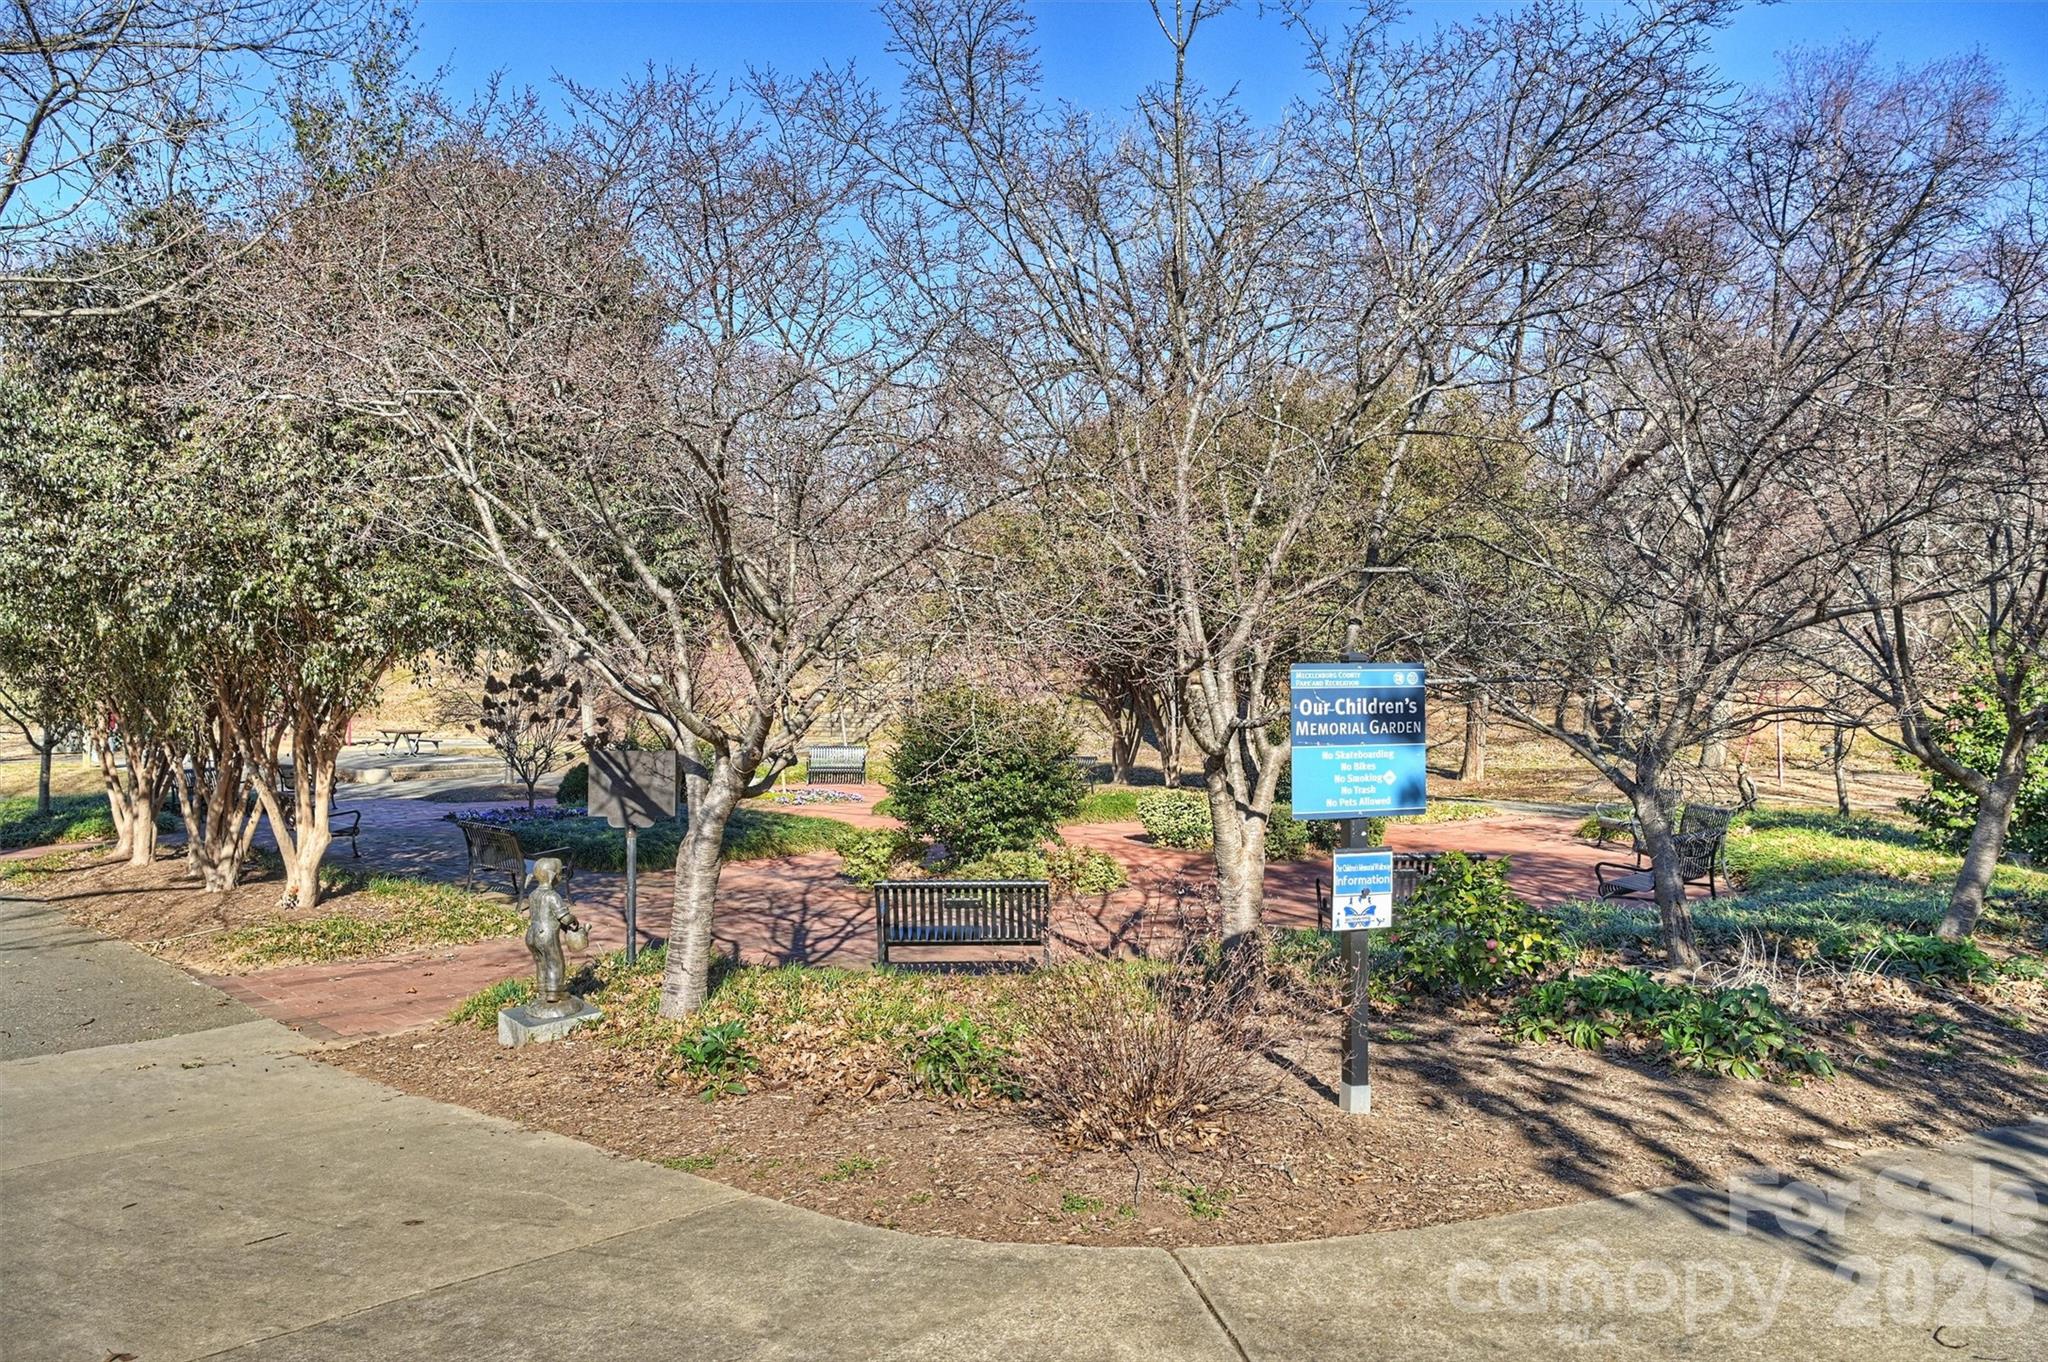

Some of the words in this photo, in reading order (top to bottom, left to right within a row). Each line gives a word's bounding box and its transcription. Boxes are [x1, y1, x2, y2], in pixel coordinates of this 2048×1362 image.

[1300, 699, 1331, 715] Our
[1335, 698, 1418, 715] Children's
[1296, 721, 1367, 736] MEMORIAL
[1369, 719, 1421, 735] GARDEN
[1322, 751, 1333, 760] No
[1335, 750, 1394, 760] Skateboarding
[1341, 763, 1352, 771] No
[1354, 762, 1376, 770] Bikes
[1334, 775, 1345, 783] No
[1347, 774, 1383, 784] Smoking
[1341, 786, 1352, 795] No
[1354, 785, 1376, 794] Trash
[1326, 799, 1338, 807] No
[1340, 798, 1358, 807] Pets
[1359, 797, 1391, 806] Allowed
[1335, 874, 1390, 885] Information
